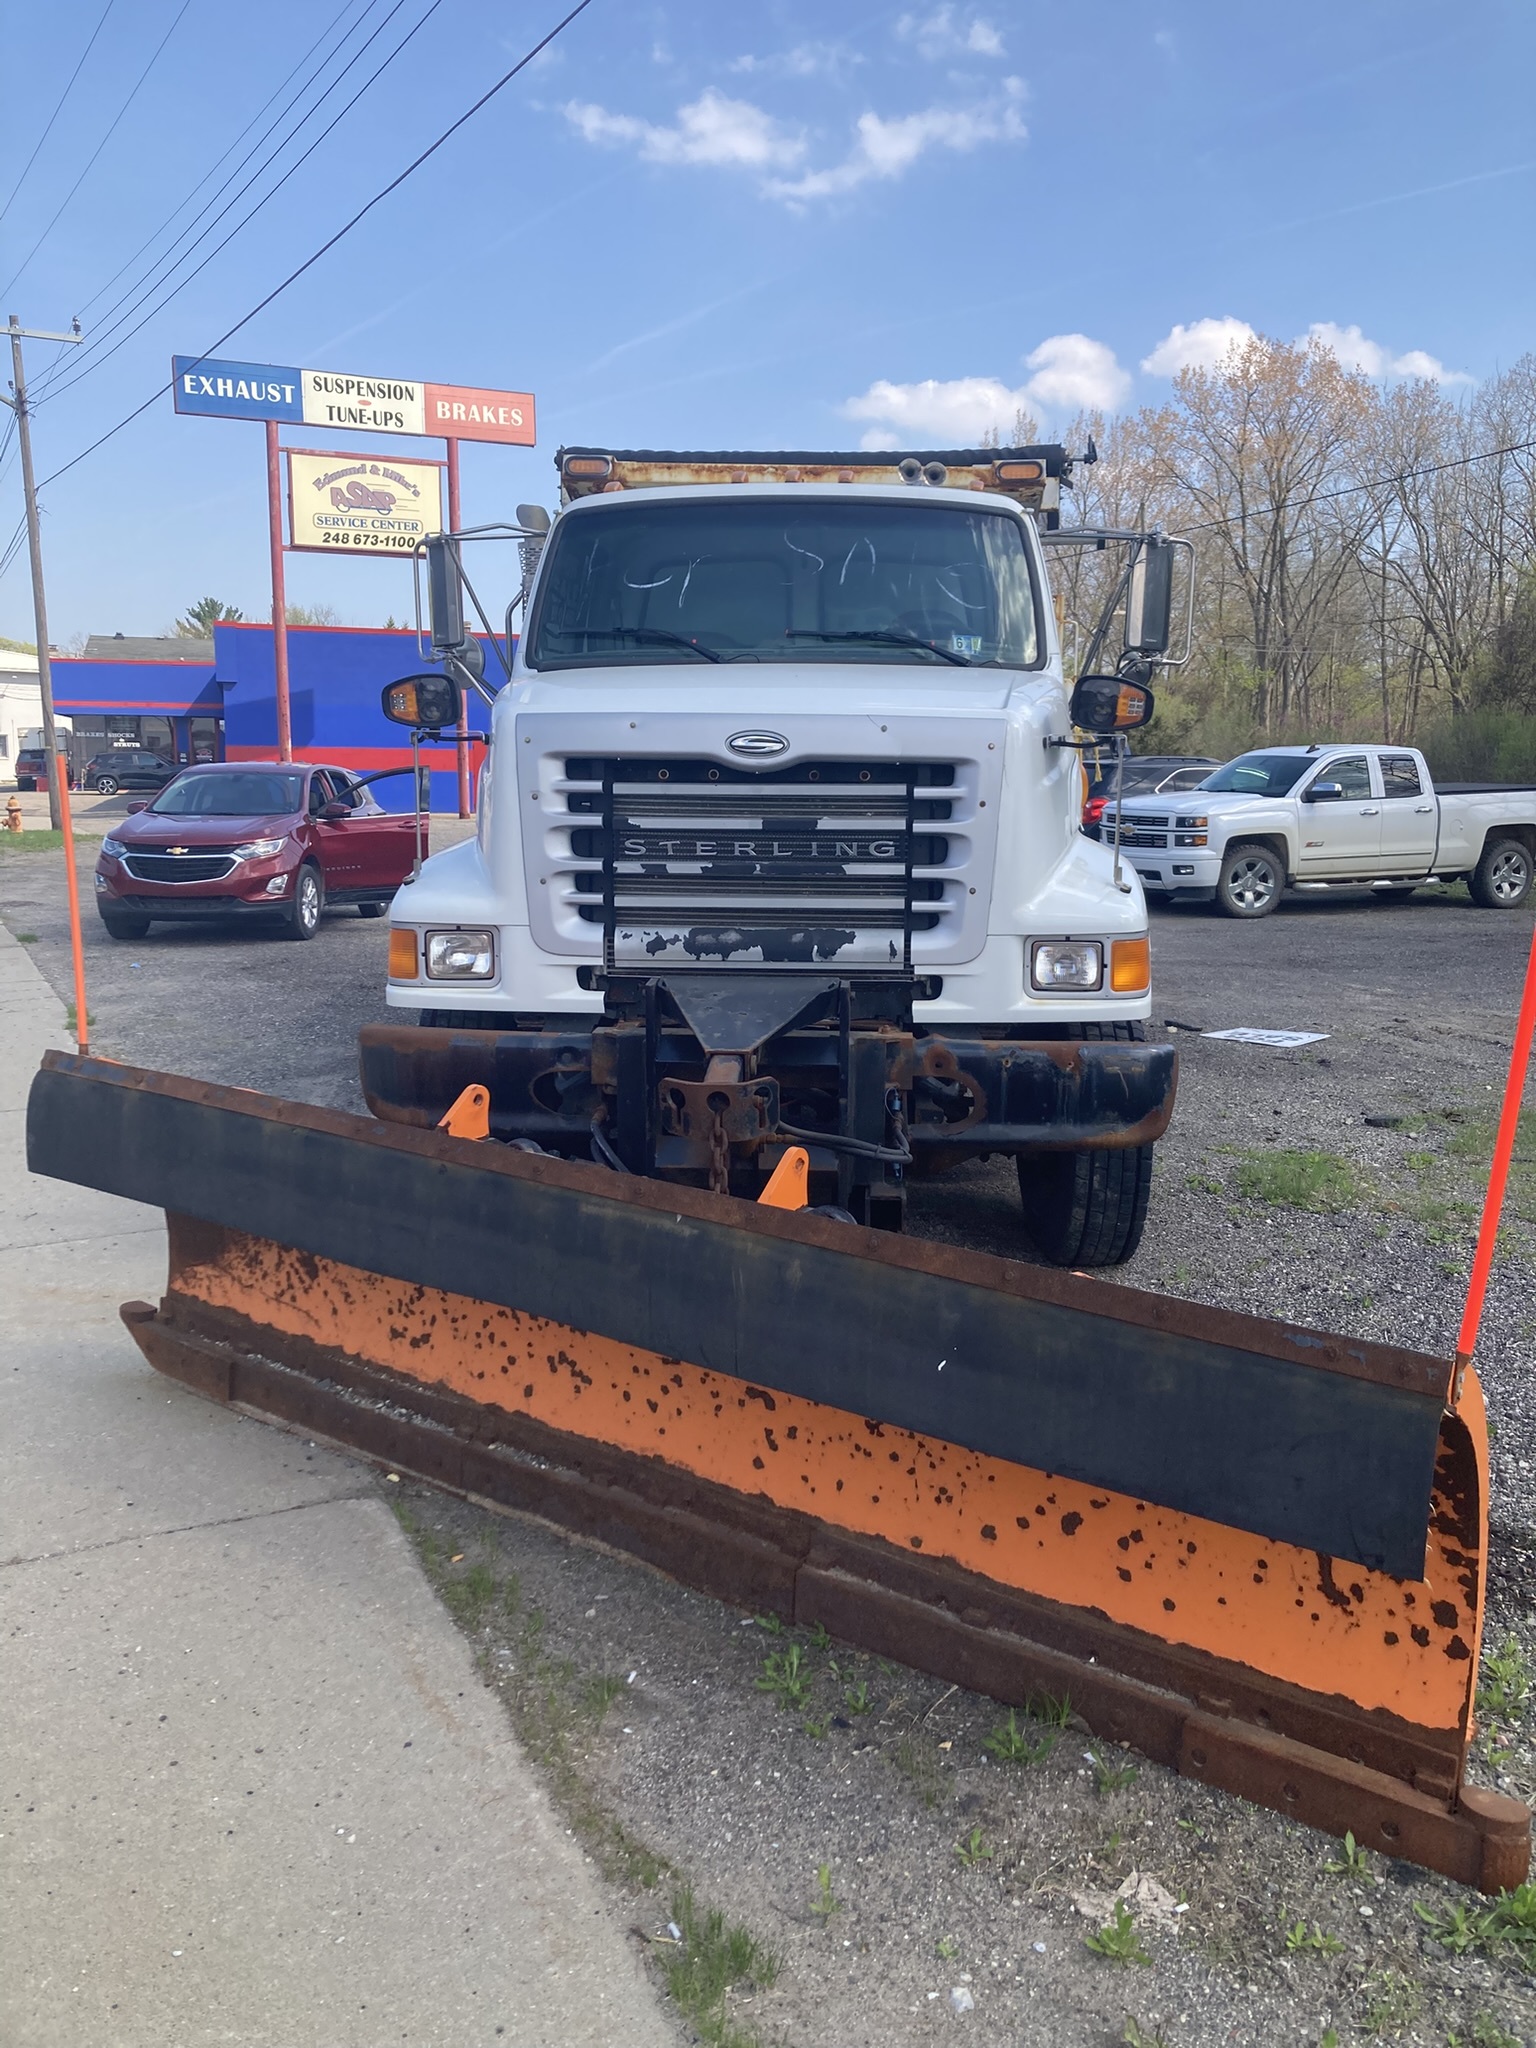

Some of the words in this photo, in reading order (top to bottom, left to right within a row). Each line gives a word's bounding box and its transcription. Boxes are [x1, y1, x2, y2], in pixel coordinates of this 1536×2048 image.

[183, 374, 295, 404] EXHAUST
[313, 375, 414, 402] SUSPENSION
[326, 405, 404, 428] TUNE-UPS
[436, 400, 523, 427] BRAKES
[369, 464, 380, 476] &
[330, 480, 397, 510] ASAP
[316, 515, 368, 528] SERVICE
[371, 519, 419, 532] CENTER
[322, 532, 350, 545] 248
[353, 533, 415, 548] 673-1100
[956, 637, 963, 649] 6
[624, 838, 896, 858] STERLING
